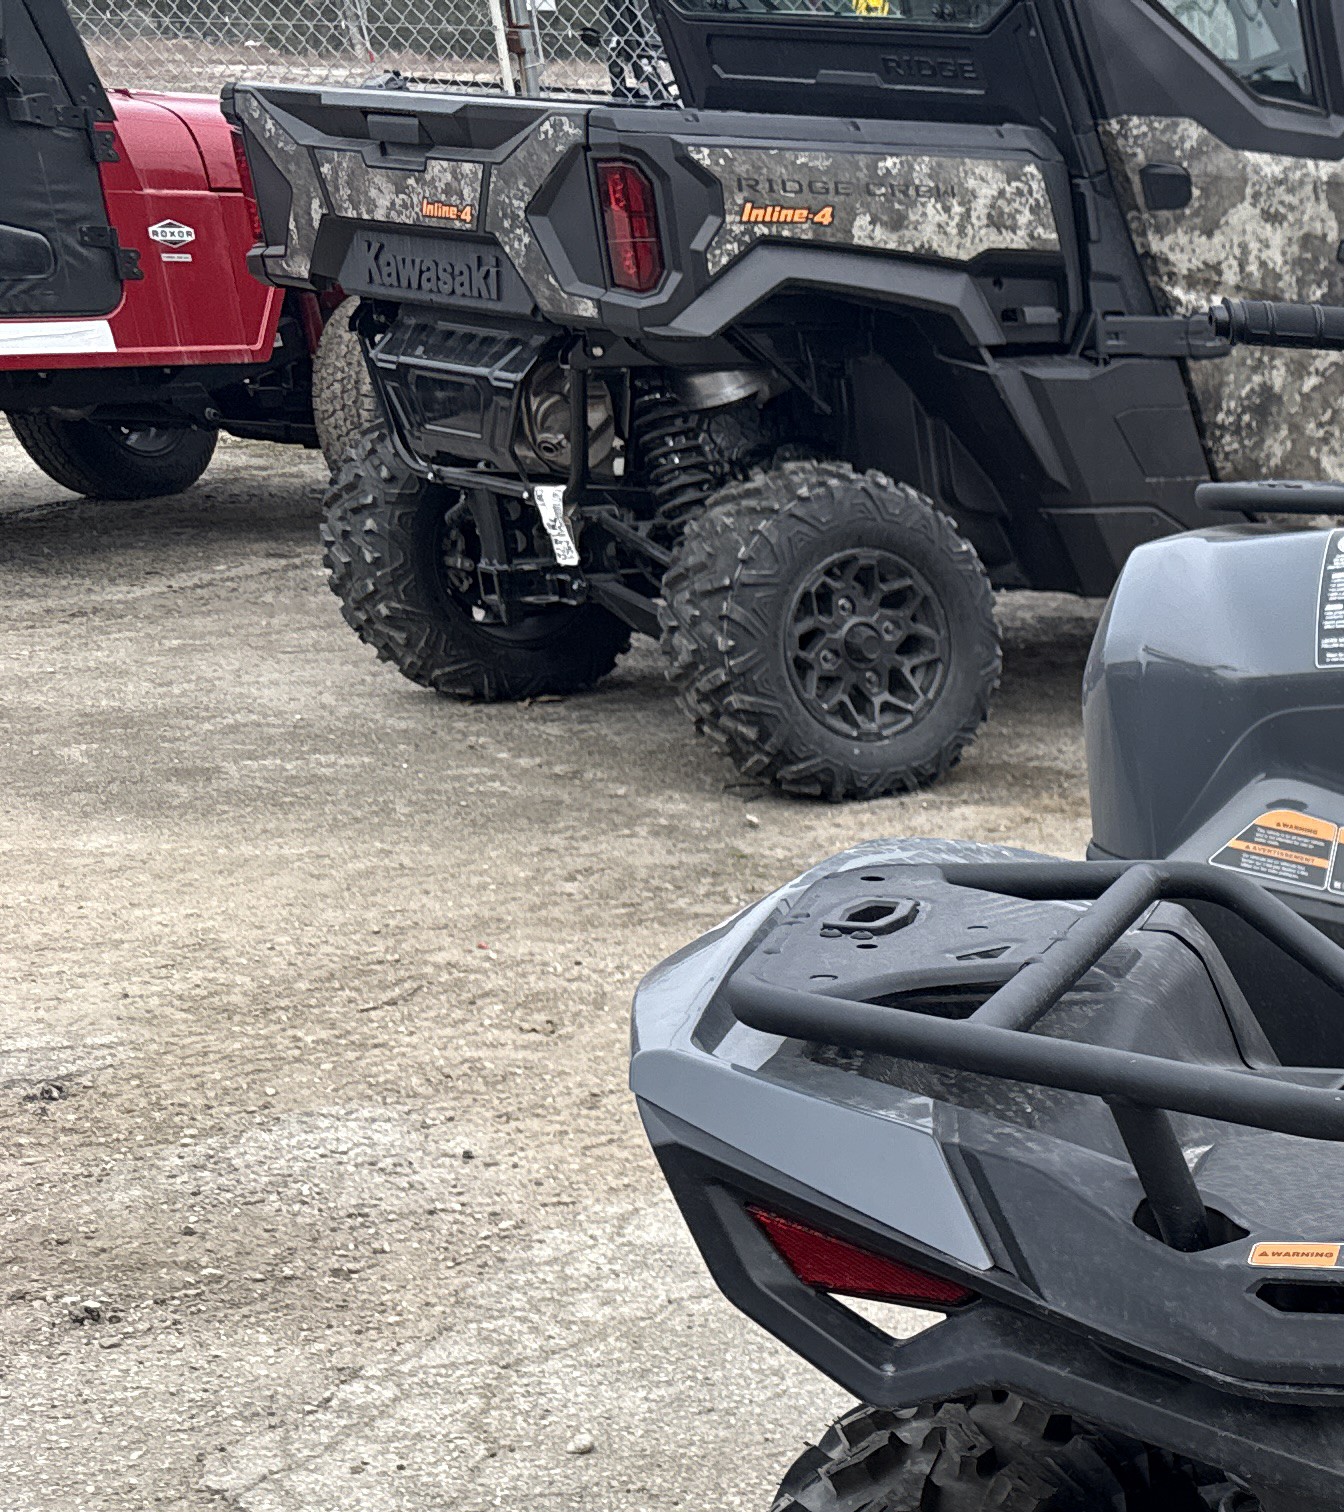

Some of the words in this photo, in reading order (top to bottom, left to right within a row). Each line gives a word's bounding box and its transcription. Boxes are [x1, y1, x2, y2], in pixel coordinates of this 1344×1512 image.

[880, 55, 977, 79] RIDGE
[736, 177, 852, 197] RIDGE
[421, 197, 473, 223] Inline-4
[740, 202, 834, 226] Inline-4
[151, 229, 194, 238] ROXOR
[365, 239, 502, 301] Kawasaki
[1271, 1251, 1335, 1259] WARNING
